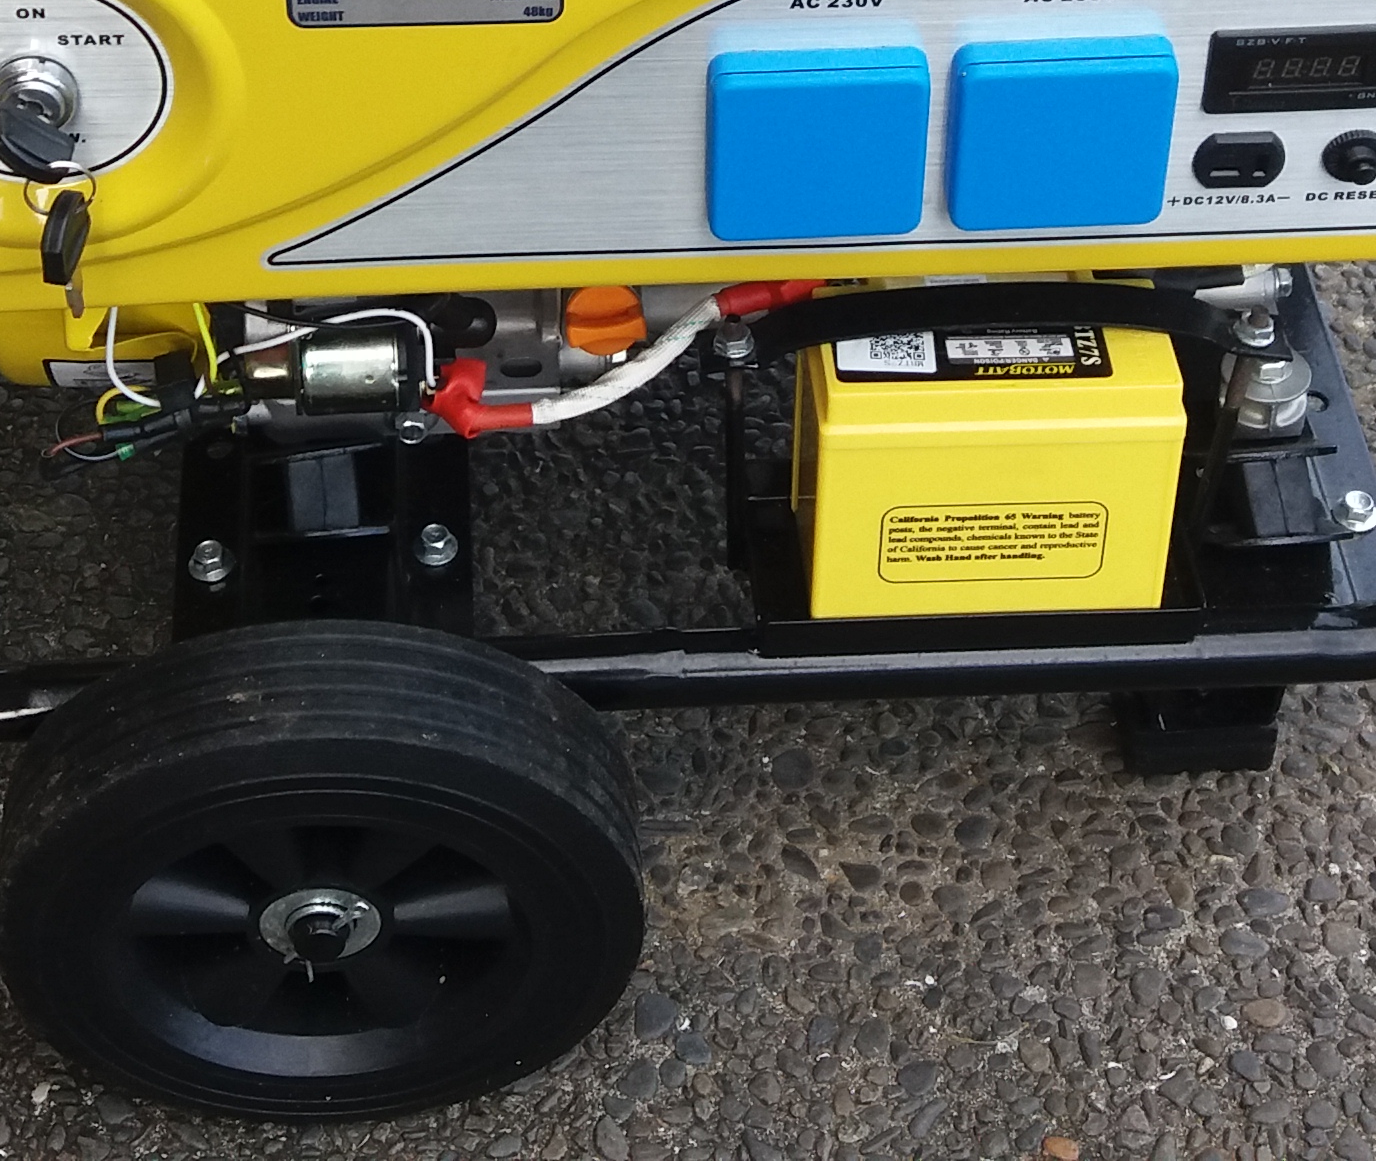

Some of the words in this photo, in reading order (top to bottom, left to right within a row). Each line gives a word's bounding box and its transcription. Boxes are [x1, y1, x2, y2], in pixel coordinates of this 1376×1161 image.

[16, 8, 45, 19] ON
[297, 11, 344, 22] WEIGHT
[523, 6, 554, 19] 48kg
[57, 34, 125, 46] START
[1305, 192, 1328, 202] DC
[975, 363, 1075, 376] MOTOBATT
[890, 515, 940, 524] California
[1021, 512, 1065, 521] Warning
[1069, 511, 1101, 520] battery
[918, 525, 933, 533] the
[936, 524, 975, 533] negative
[978, 523, 1019, 531] terminal,
[1022, 521, 1057, 530] contain
[1060, 521, 1080, 529] lead
[909, 534, 964, 544] compounds,
[966, 533, 1012, 541] chemicals
[1059, 531, 1073, 539] the
[1074, 531, 1099, 539] State
[887, 545, 899, 553] of
[899, 545, 946, 553] California
[1039, 541, 1098, 550] reproductive
[915, 554, 943, 562] Wash
[1000, 552, 1046, 560] handling.
